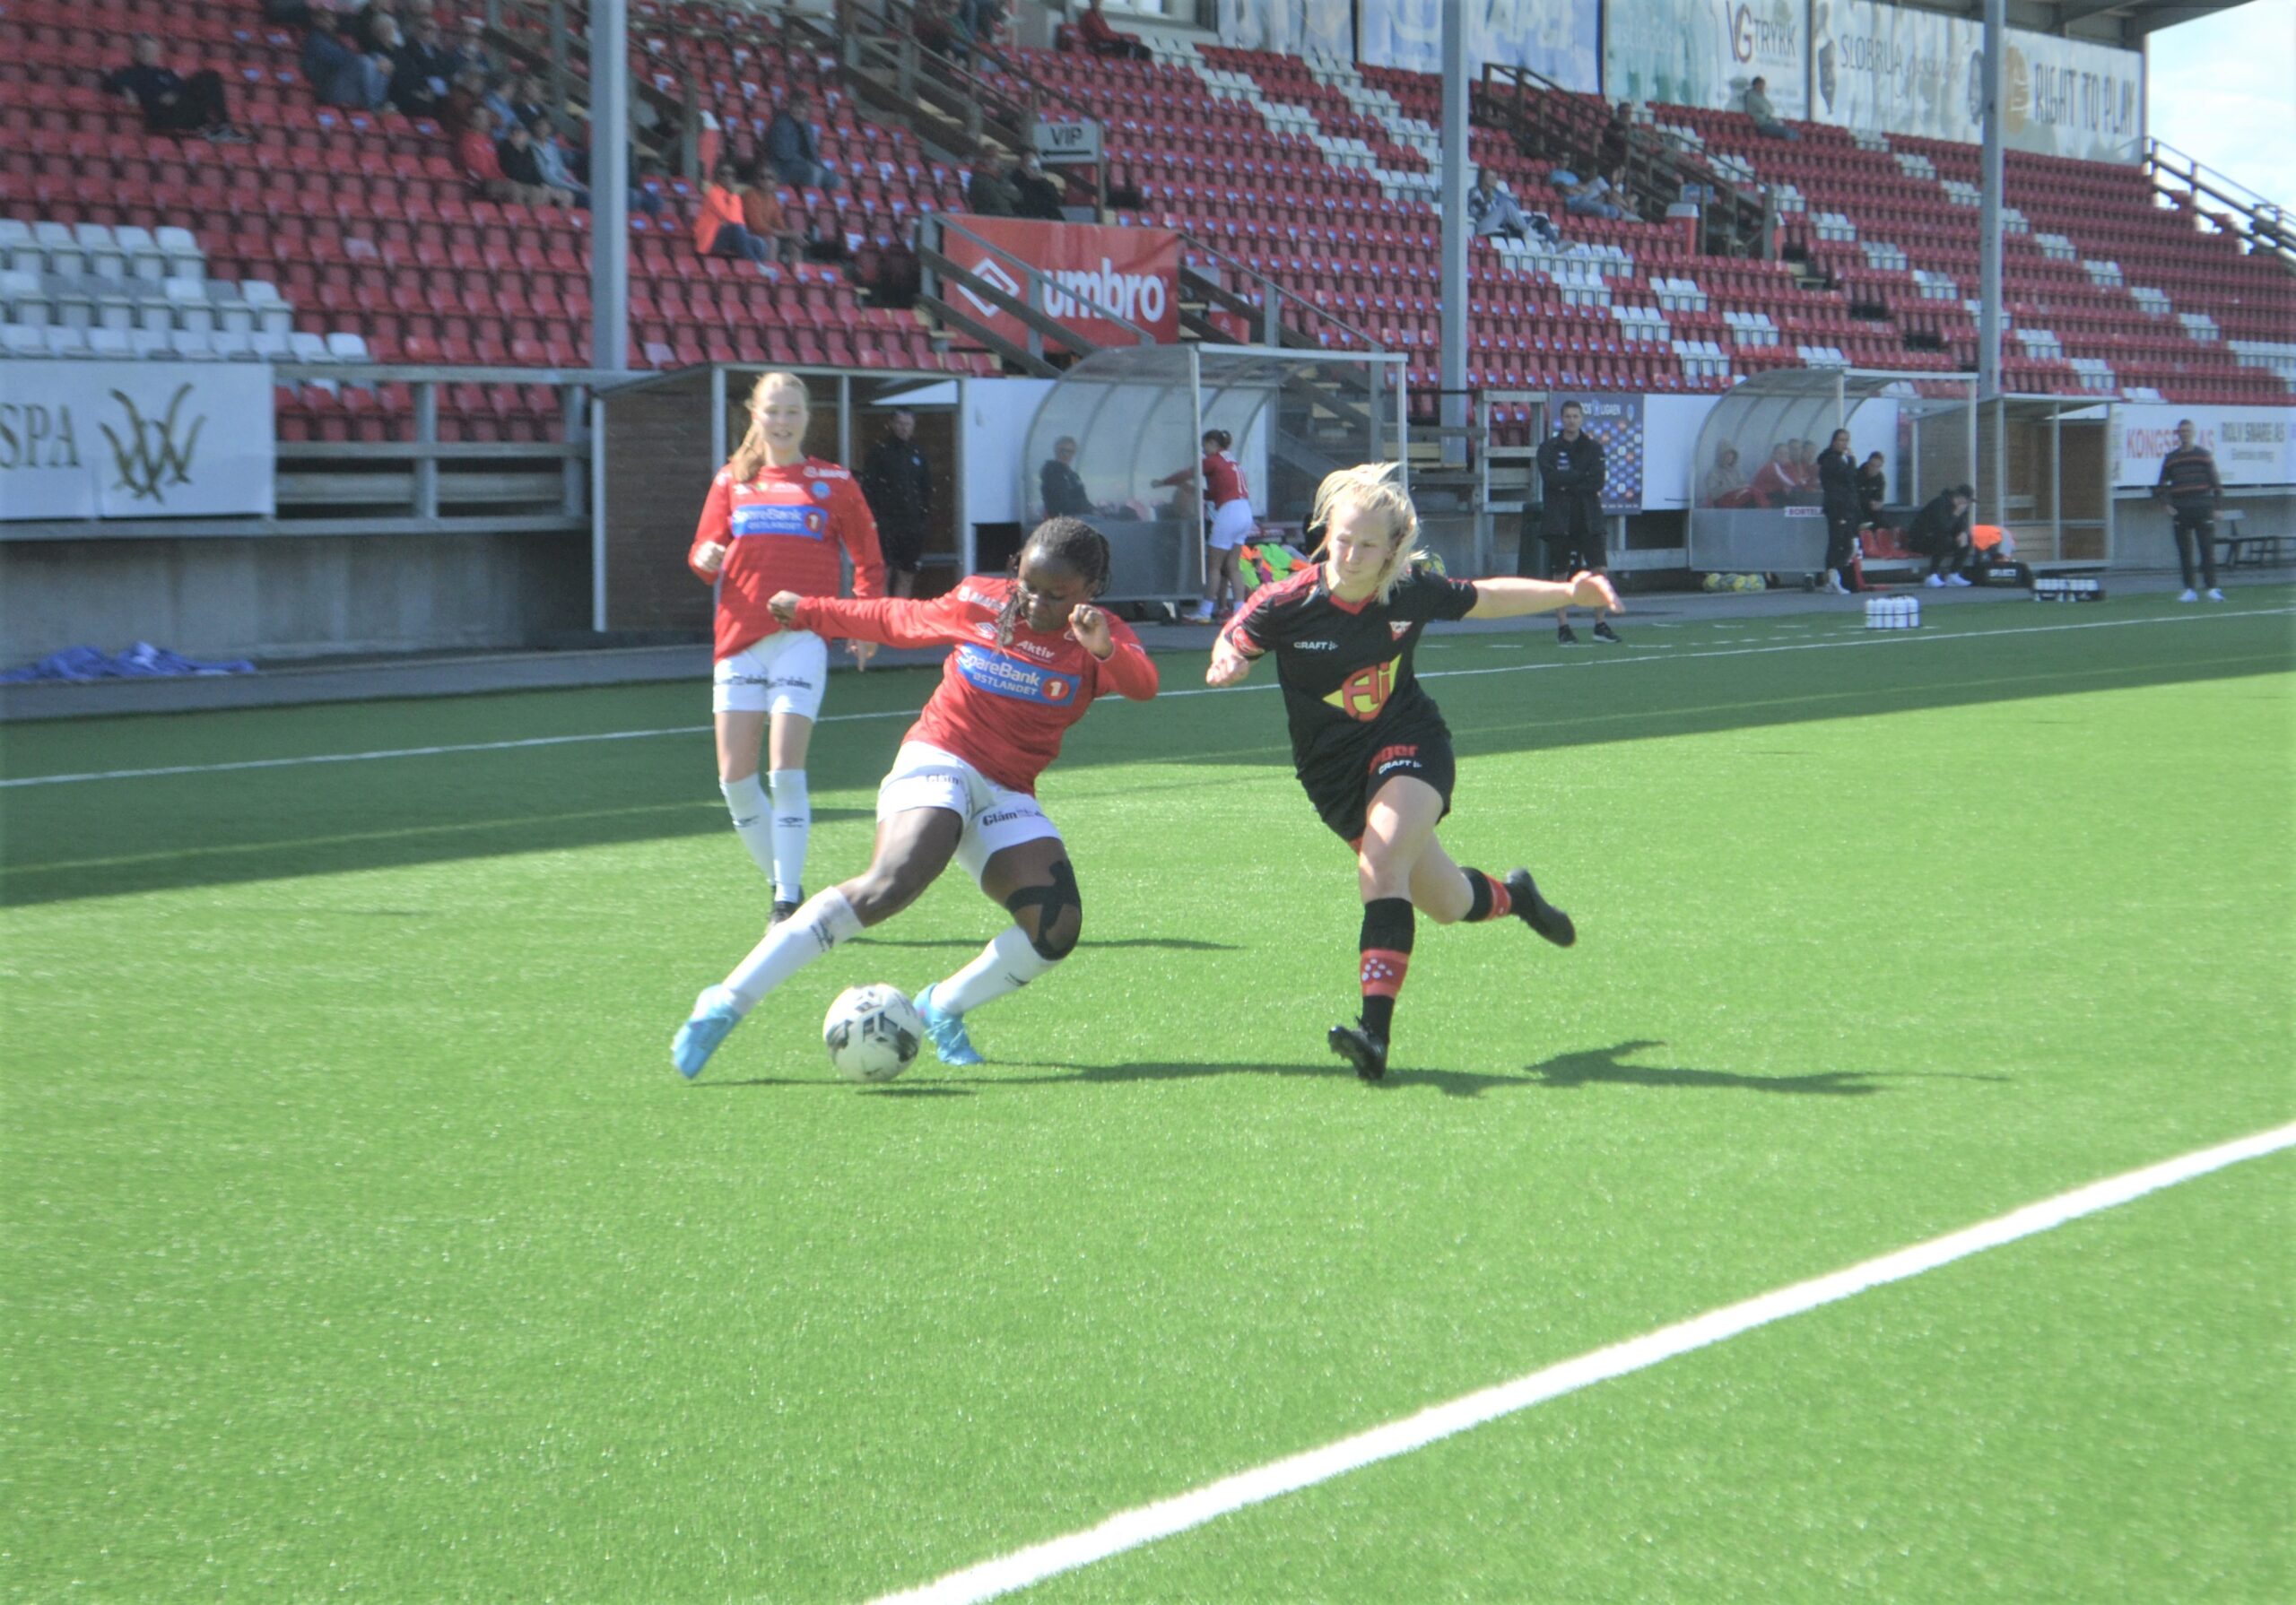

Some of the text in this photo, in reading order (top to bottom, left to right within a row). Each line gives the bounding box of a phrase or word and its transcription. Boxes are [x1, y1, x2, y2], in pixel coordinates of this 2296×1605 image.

[2035, 63, 2135, 136] RIGHT TO PLAY
[1049, 126, 1083, 146] VIP
[1043, 256, 1165, 323] umbro
[1017, 639, 1055, 660] Aktiv
[1293, 640, 1328, 650] CRAFT
[957, 645, 1041, 688] SpareBank
[972, 672, 1039, 697] ØSTLANDET
[1378, 759, 1412, 775] CRAFT
